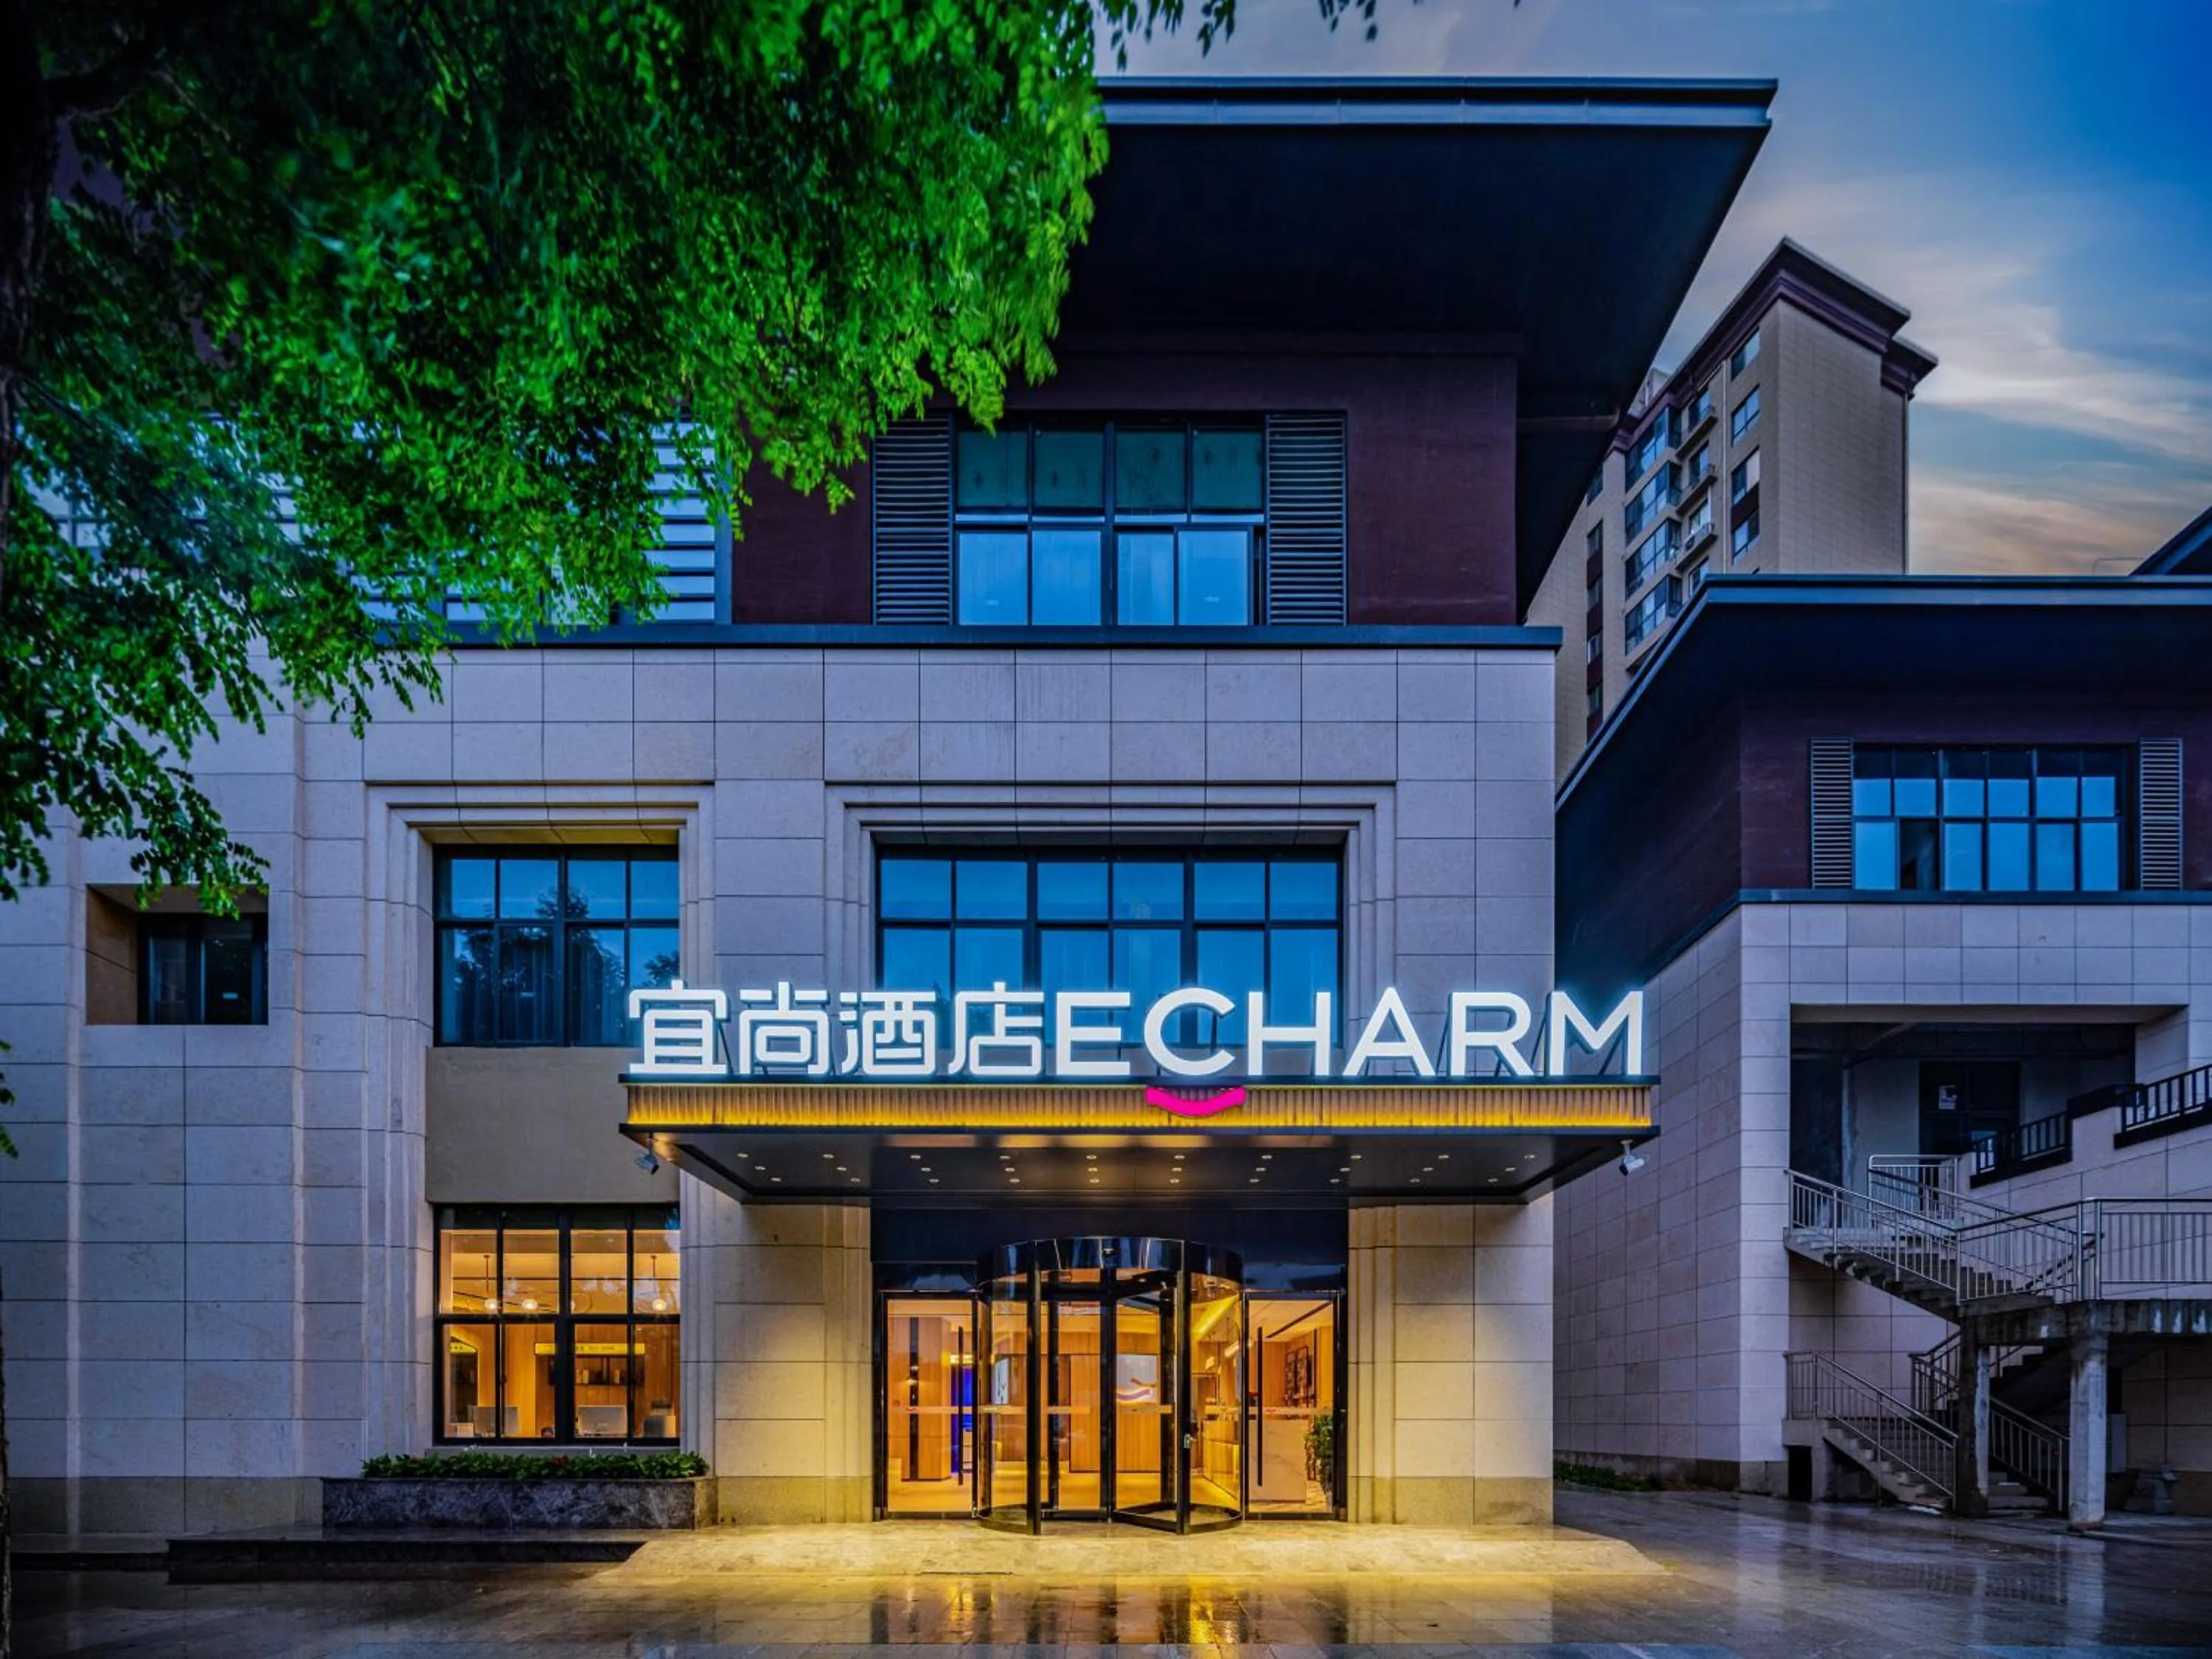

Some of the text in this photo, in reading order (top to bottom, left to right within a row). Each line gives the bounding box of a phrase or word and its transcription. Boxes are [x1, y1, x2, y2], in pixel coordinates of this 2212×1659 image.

[629, 979, 1643, 1076] 宜尚酒店 ECHARM
